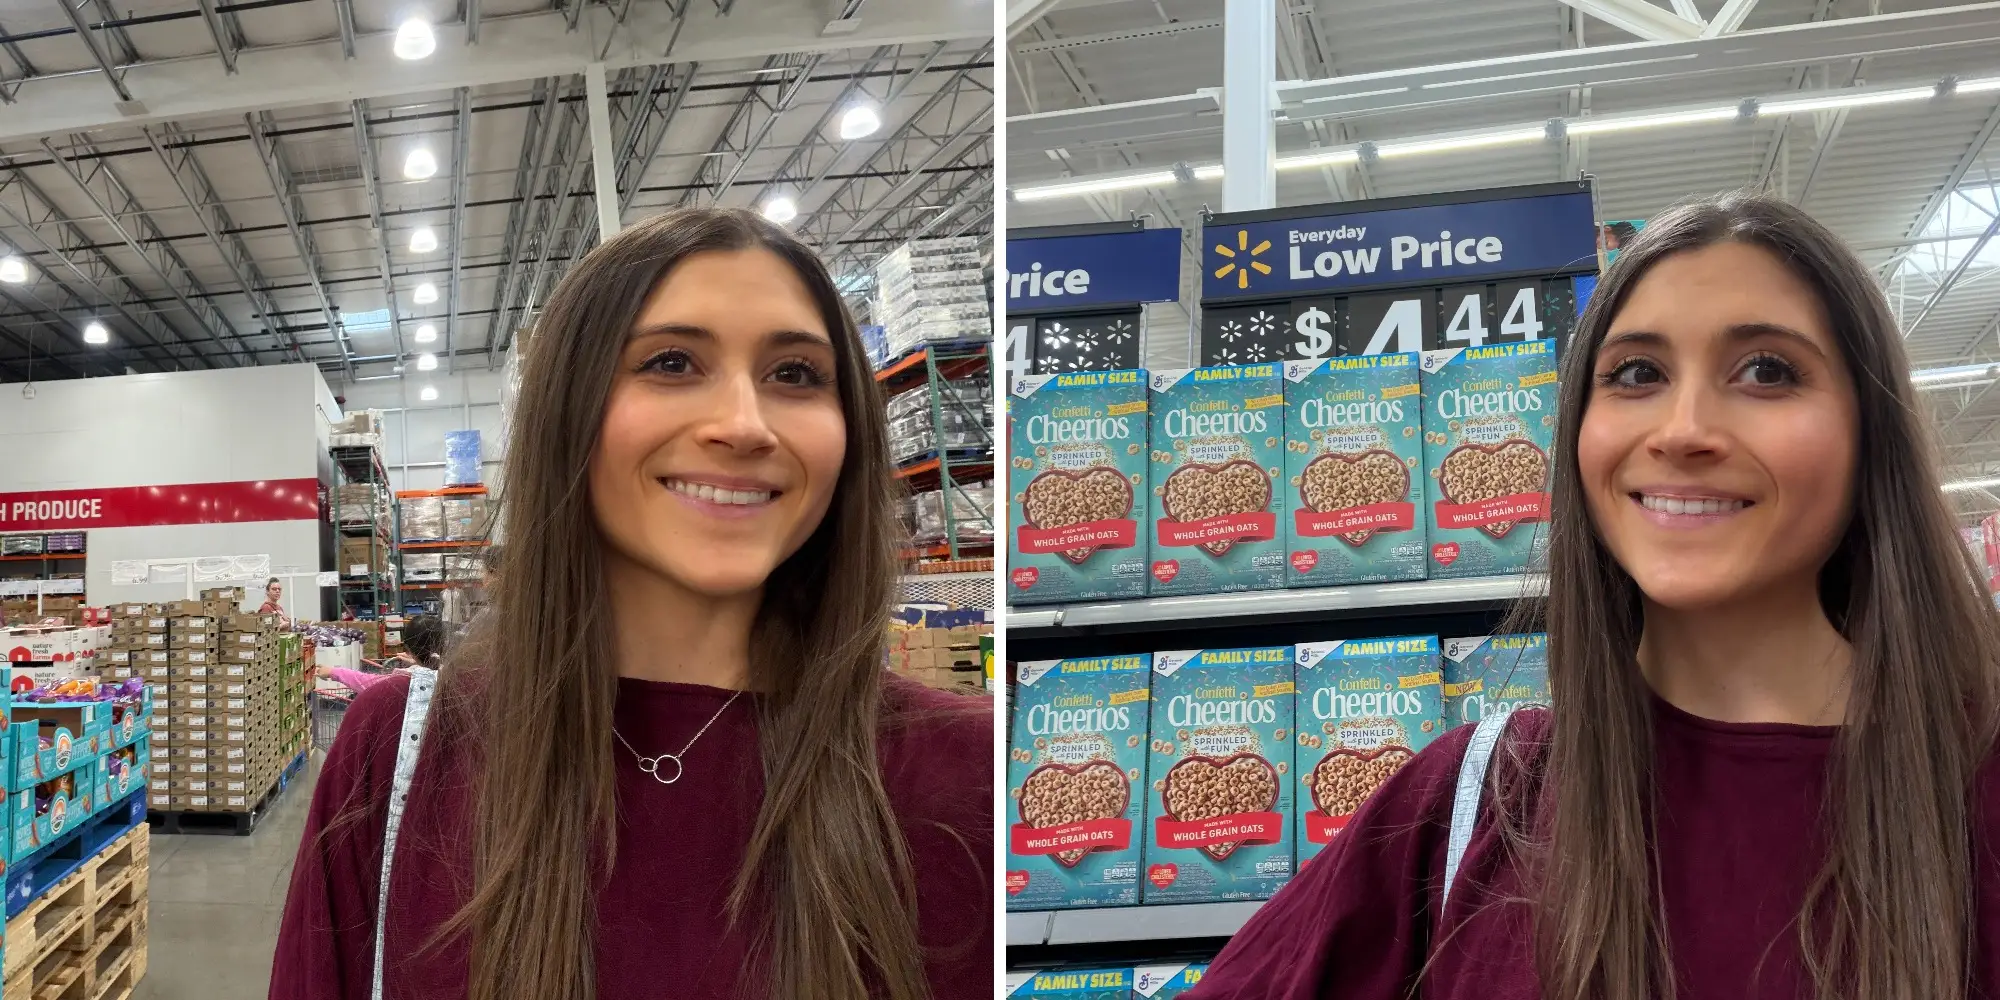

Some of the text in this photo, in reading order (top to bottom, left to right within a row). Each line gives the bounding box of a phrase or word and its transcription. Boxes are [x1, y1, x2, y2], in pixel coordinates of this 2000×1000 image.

[1289, 225, 1366, 244] Everyday
[1289, 231, 1503, 280] Low Price
[1006, 262, 1090, 298] rice
[1465, 345, 1514, 360] FAMILY
[1517, 342, 1546, 356] SIZE
[1329, 355, 1409, 371] FAMILY SIZE
[1057, 372, 1137, 387] FAMILY SIZE
[1194, 365, 1273, 381] FAMILY SIZE
[1463, 379, 1502, 392] Confetti
[1326, 389, 1365, 402] Confetti
[1437, 386, 1542, 419] Cheerios
[1052, 405, 1091, 418] Confetti
[1190, 400, 1229, 413] Confetti
[1300, 396, 1404, 428] Cheerios
[1026, 413, 1130, 444] Cheerios
[1164, 407, 1267, 438] Cheerios
[1465, 424, 1516, 434] SPRINKLED
[1327, 435, 1377, 444] SPRINKLED
[1481, 432, 1500, 441] FUN
[1051, 451, 1102, 460] SPRINKLED
[1190, 444, 1240, 455] SPRINKLED
[12, 499, 102, 521] PRODUCE
[1453, 504, 1539, 523] WHOLE GRAIN OATS
[1312, 513, 1398, 531] WHOLE GRAIN OATS
[1034, 530, 1119, 547] WHOLE GRAIN OATS
[1174, 523, 1259, 541] WHOLE GRAIN OATS
[1343, 639, 1428, 656] FAMILY SIZE
[1492, 636, 1541, 650] FAMILY
[1202, 649, 1284, 664] FAMILY SIZE
[1061, 657, 1140, 673] FAMILY SIZE
[1339, 677, 1380, 691] Confetti
[1488, 685, 1531, 699] Confetti
[1054, 694, 1093, 707] Confetti
[1195, 686, 1236, 699] Confetti
[1167, 692, 1276, 727] Cheerios
[1312, 684, 1422, 720] Cheerios
[1027, 701, 1130, 736] Cheerios
[1340, 728, 1394, 738] SPRINKLED
[1051, 744, 1101, 753] SPRINKLED
[1194, 737, 1247, 746] SPRINKLED
[1357, 738, 1377, 746] FUN
[1066, 752, 1084, 760] FUN
[1027, 830, 1114, 848] WHOLE GRAIN OATS
[1173, 825, 1264, 841] WHOLE GRAIN OATS
[1034, 972, 1123, 990] FAMILY SIZE
